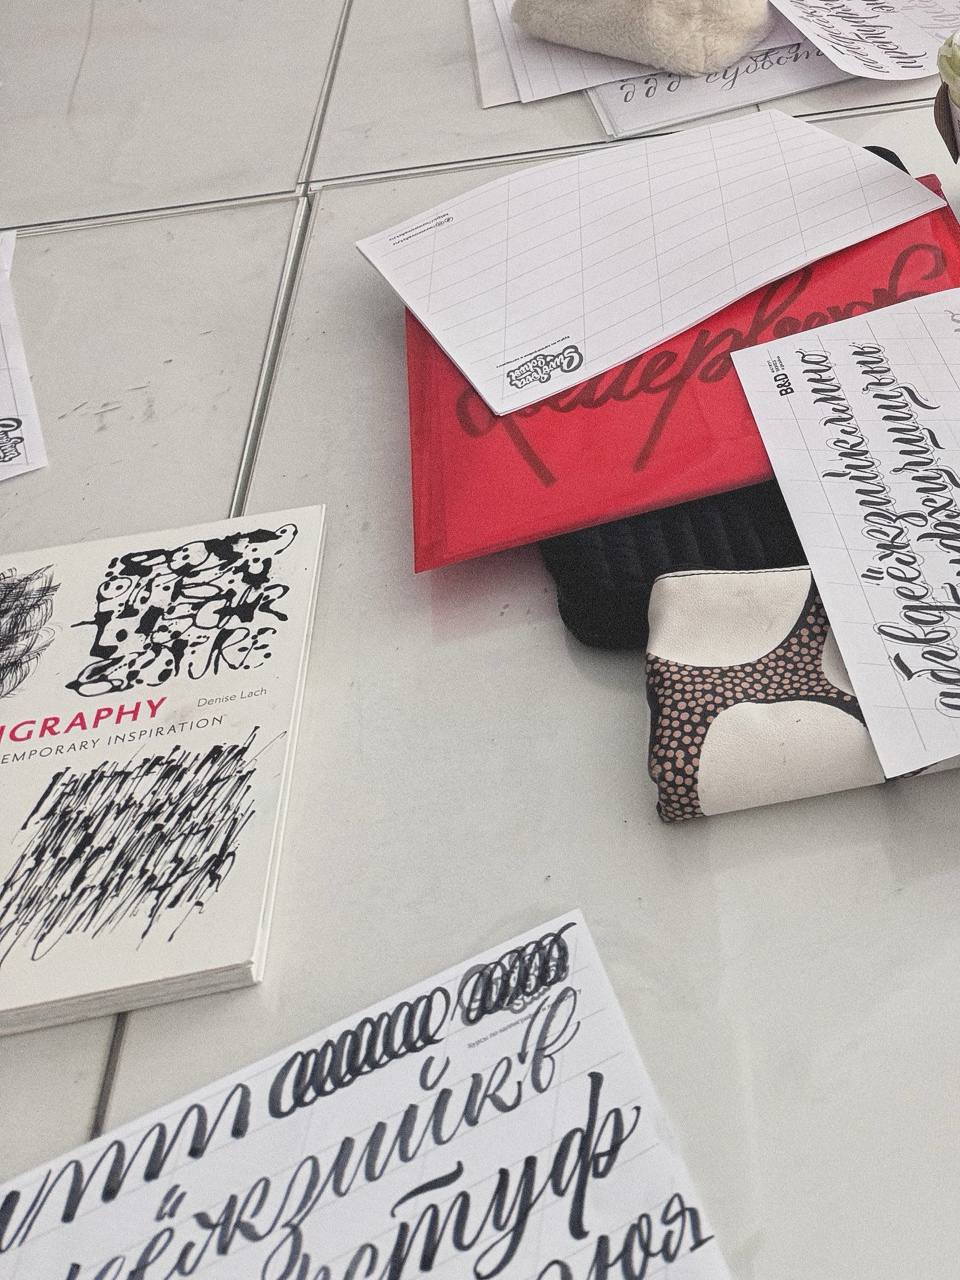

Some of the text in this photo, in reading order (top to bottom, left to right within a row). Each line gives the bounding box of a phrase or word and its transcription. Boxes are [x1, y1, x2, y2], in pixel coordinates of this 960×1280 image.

[705, 43, 826, 90] суббот
[197, 687, 267, 708] Denise Lach
[107, 714, 224, 746] INSPIRATION
